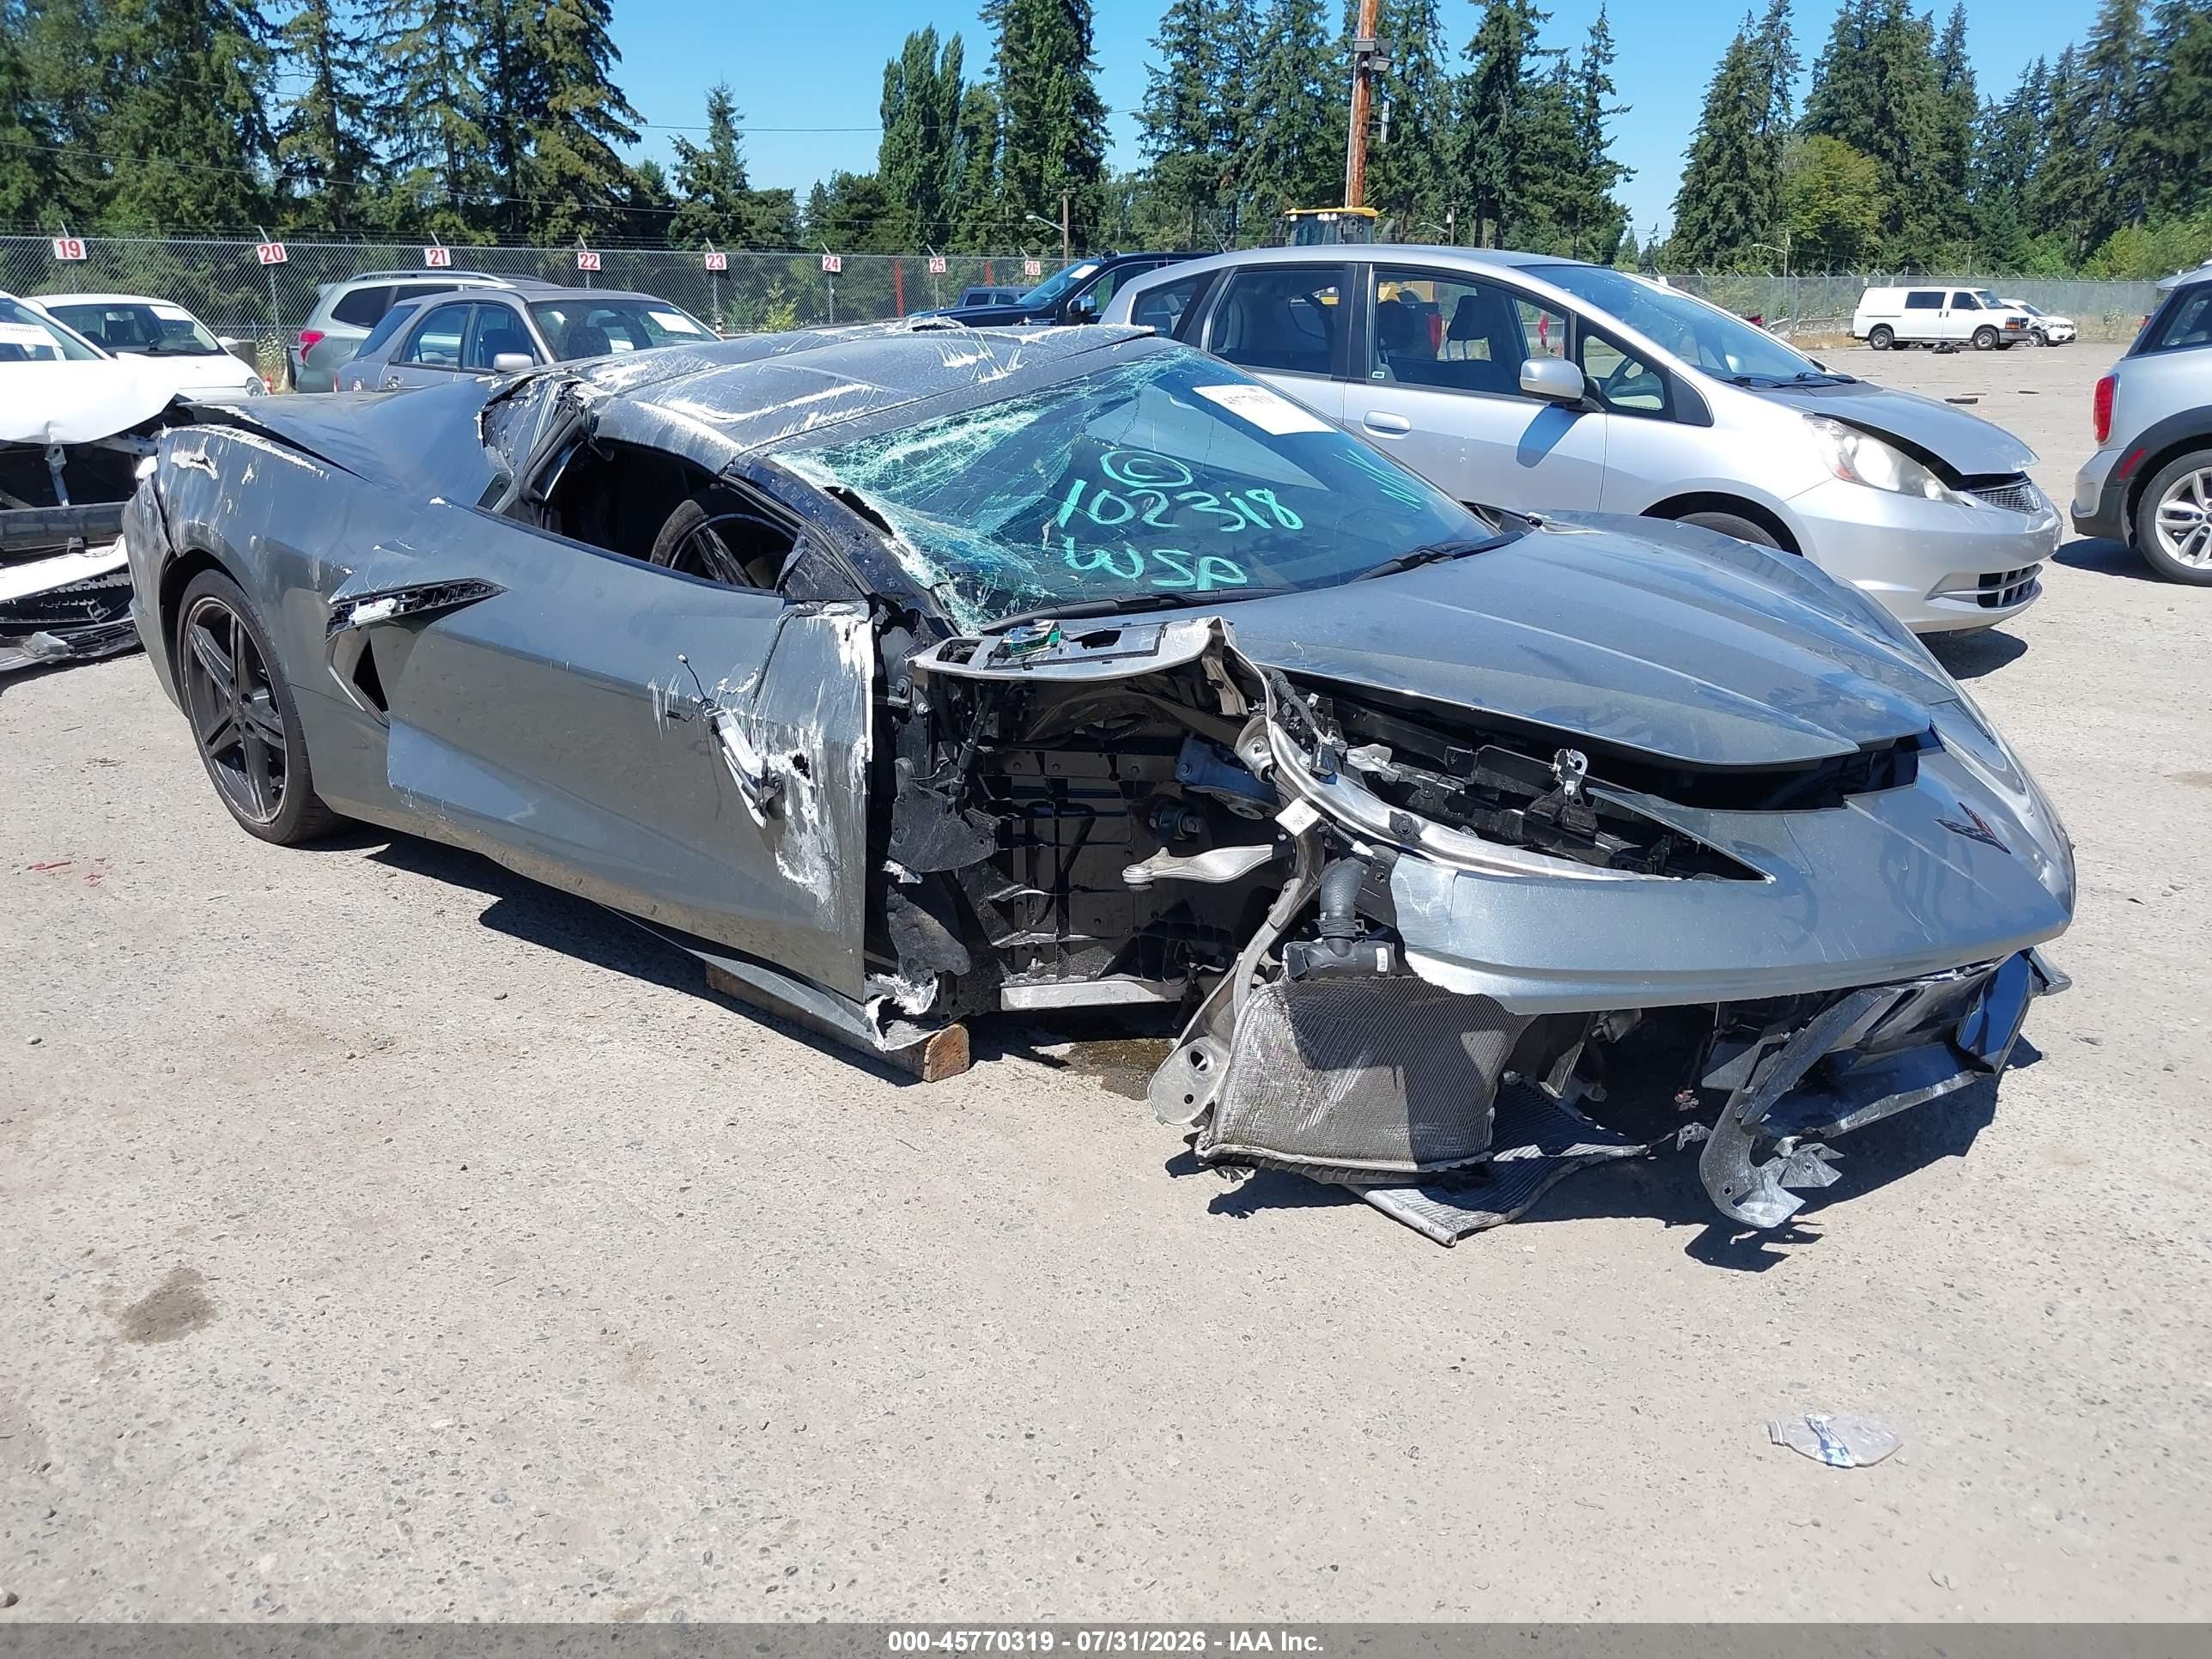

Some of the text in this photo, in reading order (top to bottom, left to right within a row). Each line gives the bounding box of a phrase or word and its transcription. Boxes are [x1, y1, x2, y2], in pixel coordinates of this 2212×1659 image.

[58, 240, 81, 258] 19
[260, 245, 284, 262] 20
[429, 250, 447, 265] 21
[580, 254, 598, 269] 22
[708, 254, 724, 269] 23
[824, 257, 839, 270] 24
[931, 259, 944, 271] 25
[1026, 262, 1039, 275] 26
[1058, 478, 1304, 532] 102318
[1060, 535, 1248, 591] WSP
